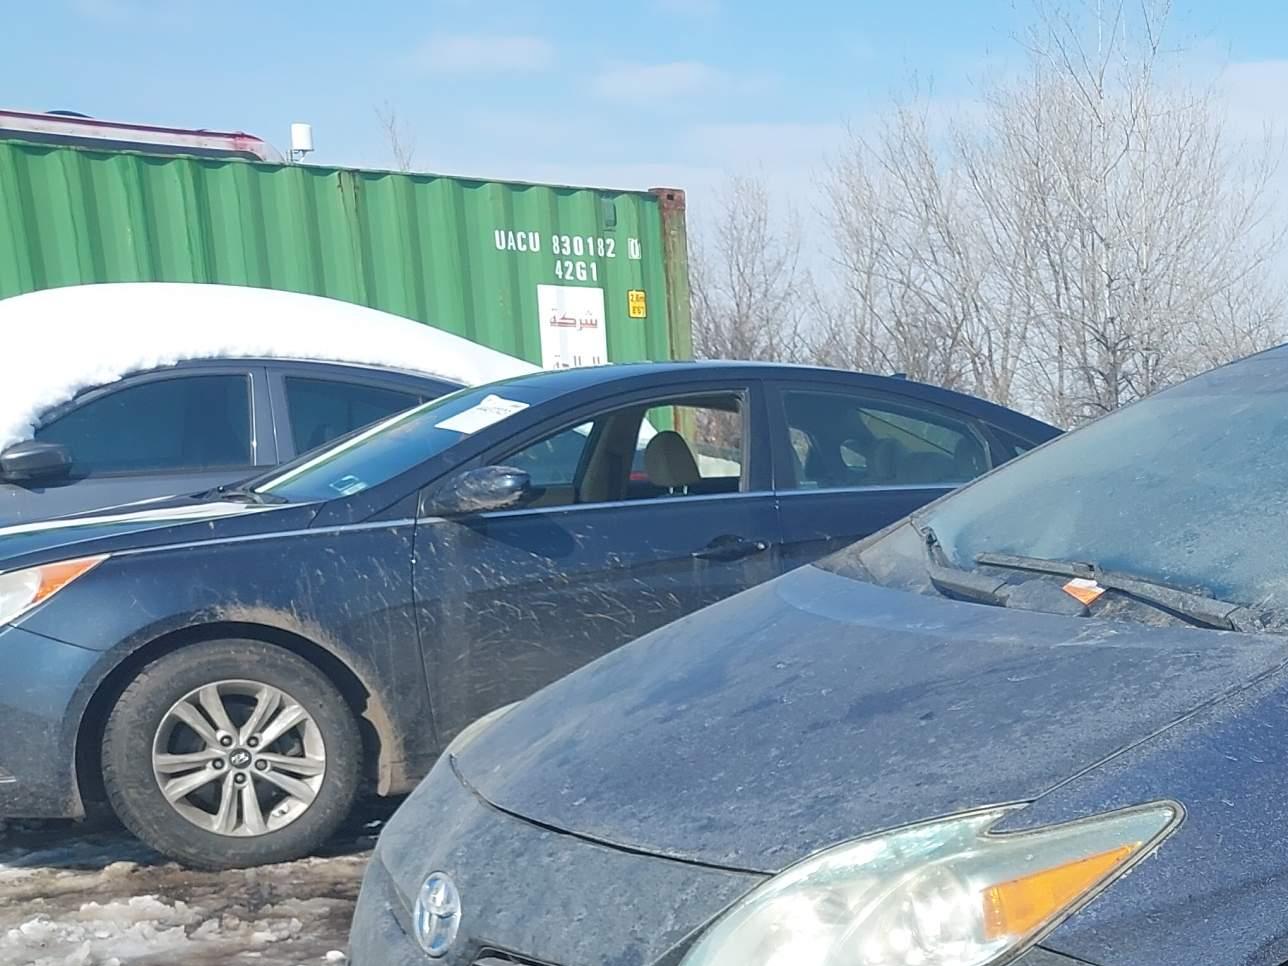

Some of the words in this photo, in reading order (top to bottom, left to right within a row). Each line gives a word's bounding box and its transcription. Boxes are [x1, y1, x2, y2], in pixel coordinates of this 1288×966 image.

[495, 230, 540, 252] UACU
[552, 235, 616, 258] 830182
[555, 260, 598, 281] 42G1
